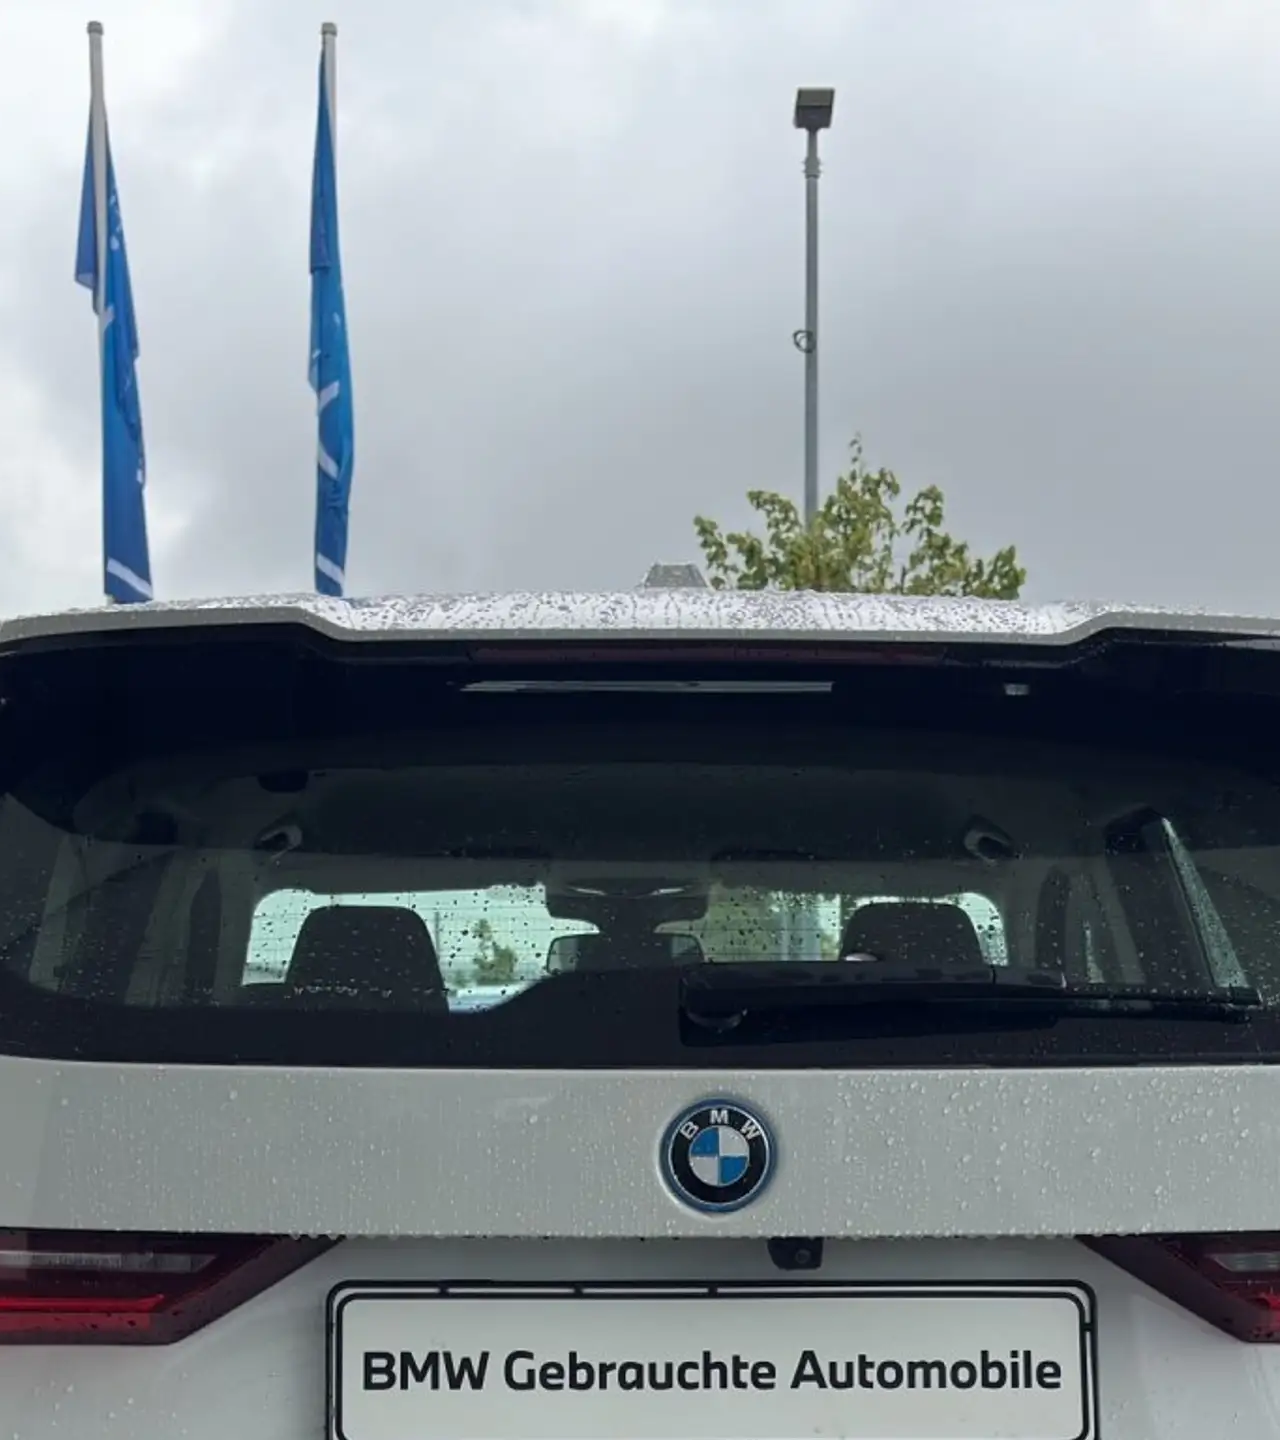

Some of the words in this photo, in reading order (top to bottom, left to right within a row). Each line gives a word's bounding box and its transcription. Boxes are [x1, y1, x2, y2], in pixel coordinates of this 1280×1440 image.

[679, 1108, 763, 1141] BMW
[363, 1351, 490, 1391] BMW
[504, 1350, 776, 1391] Gebrauchte
[790, 1349, 1062, 1390] Automobile
